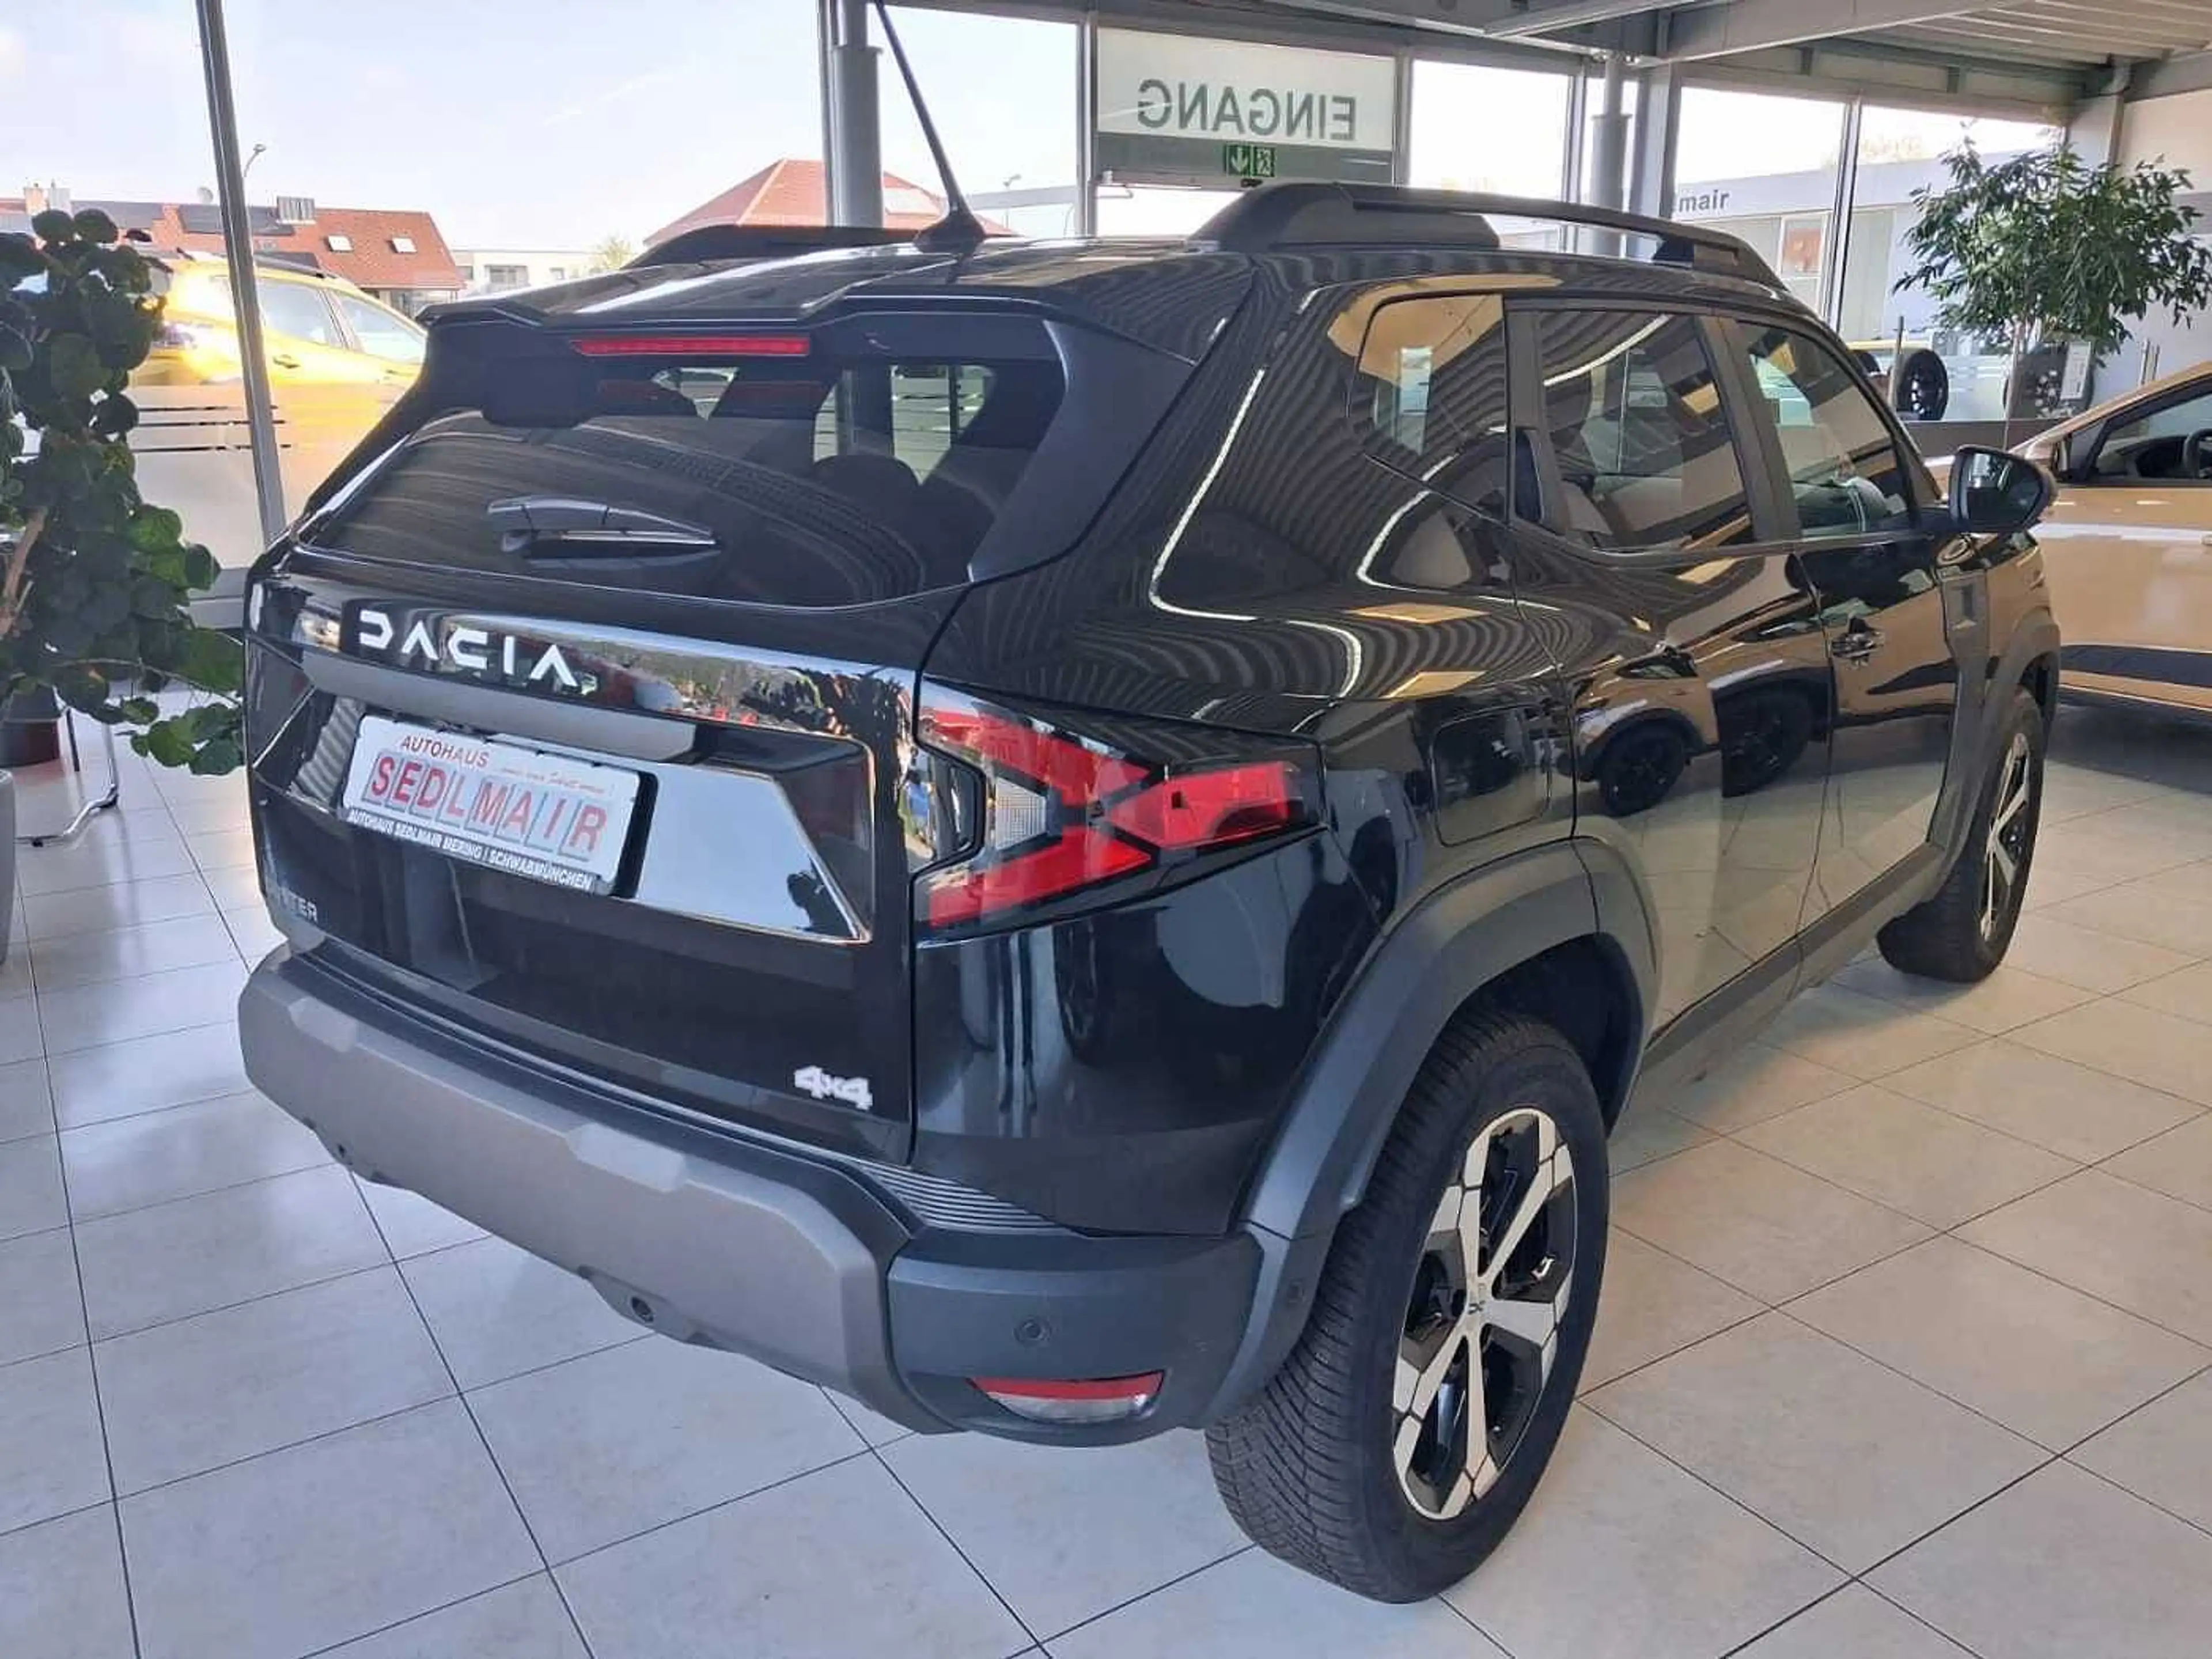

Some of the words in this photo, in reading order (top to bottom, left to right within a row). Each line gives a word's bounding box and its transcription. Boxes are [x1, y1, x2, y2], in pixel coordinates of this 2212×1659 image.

[360, 610, 578, 686] DACIA
[402, 736, 490, 768] AUTOHAUS
[372, 756, 607, 852] SEDLMAIR
